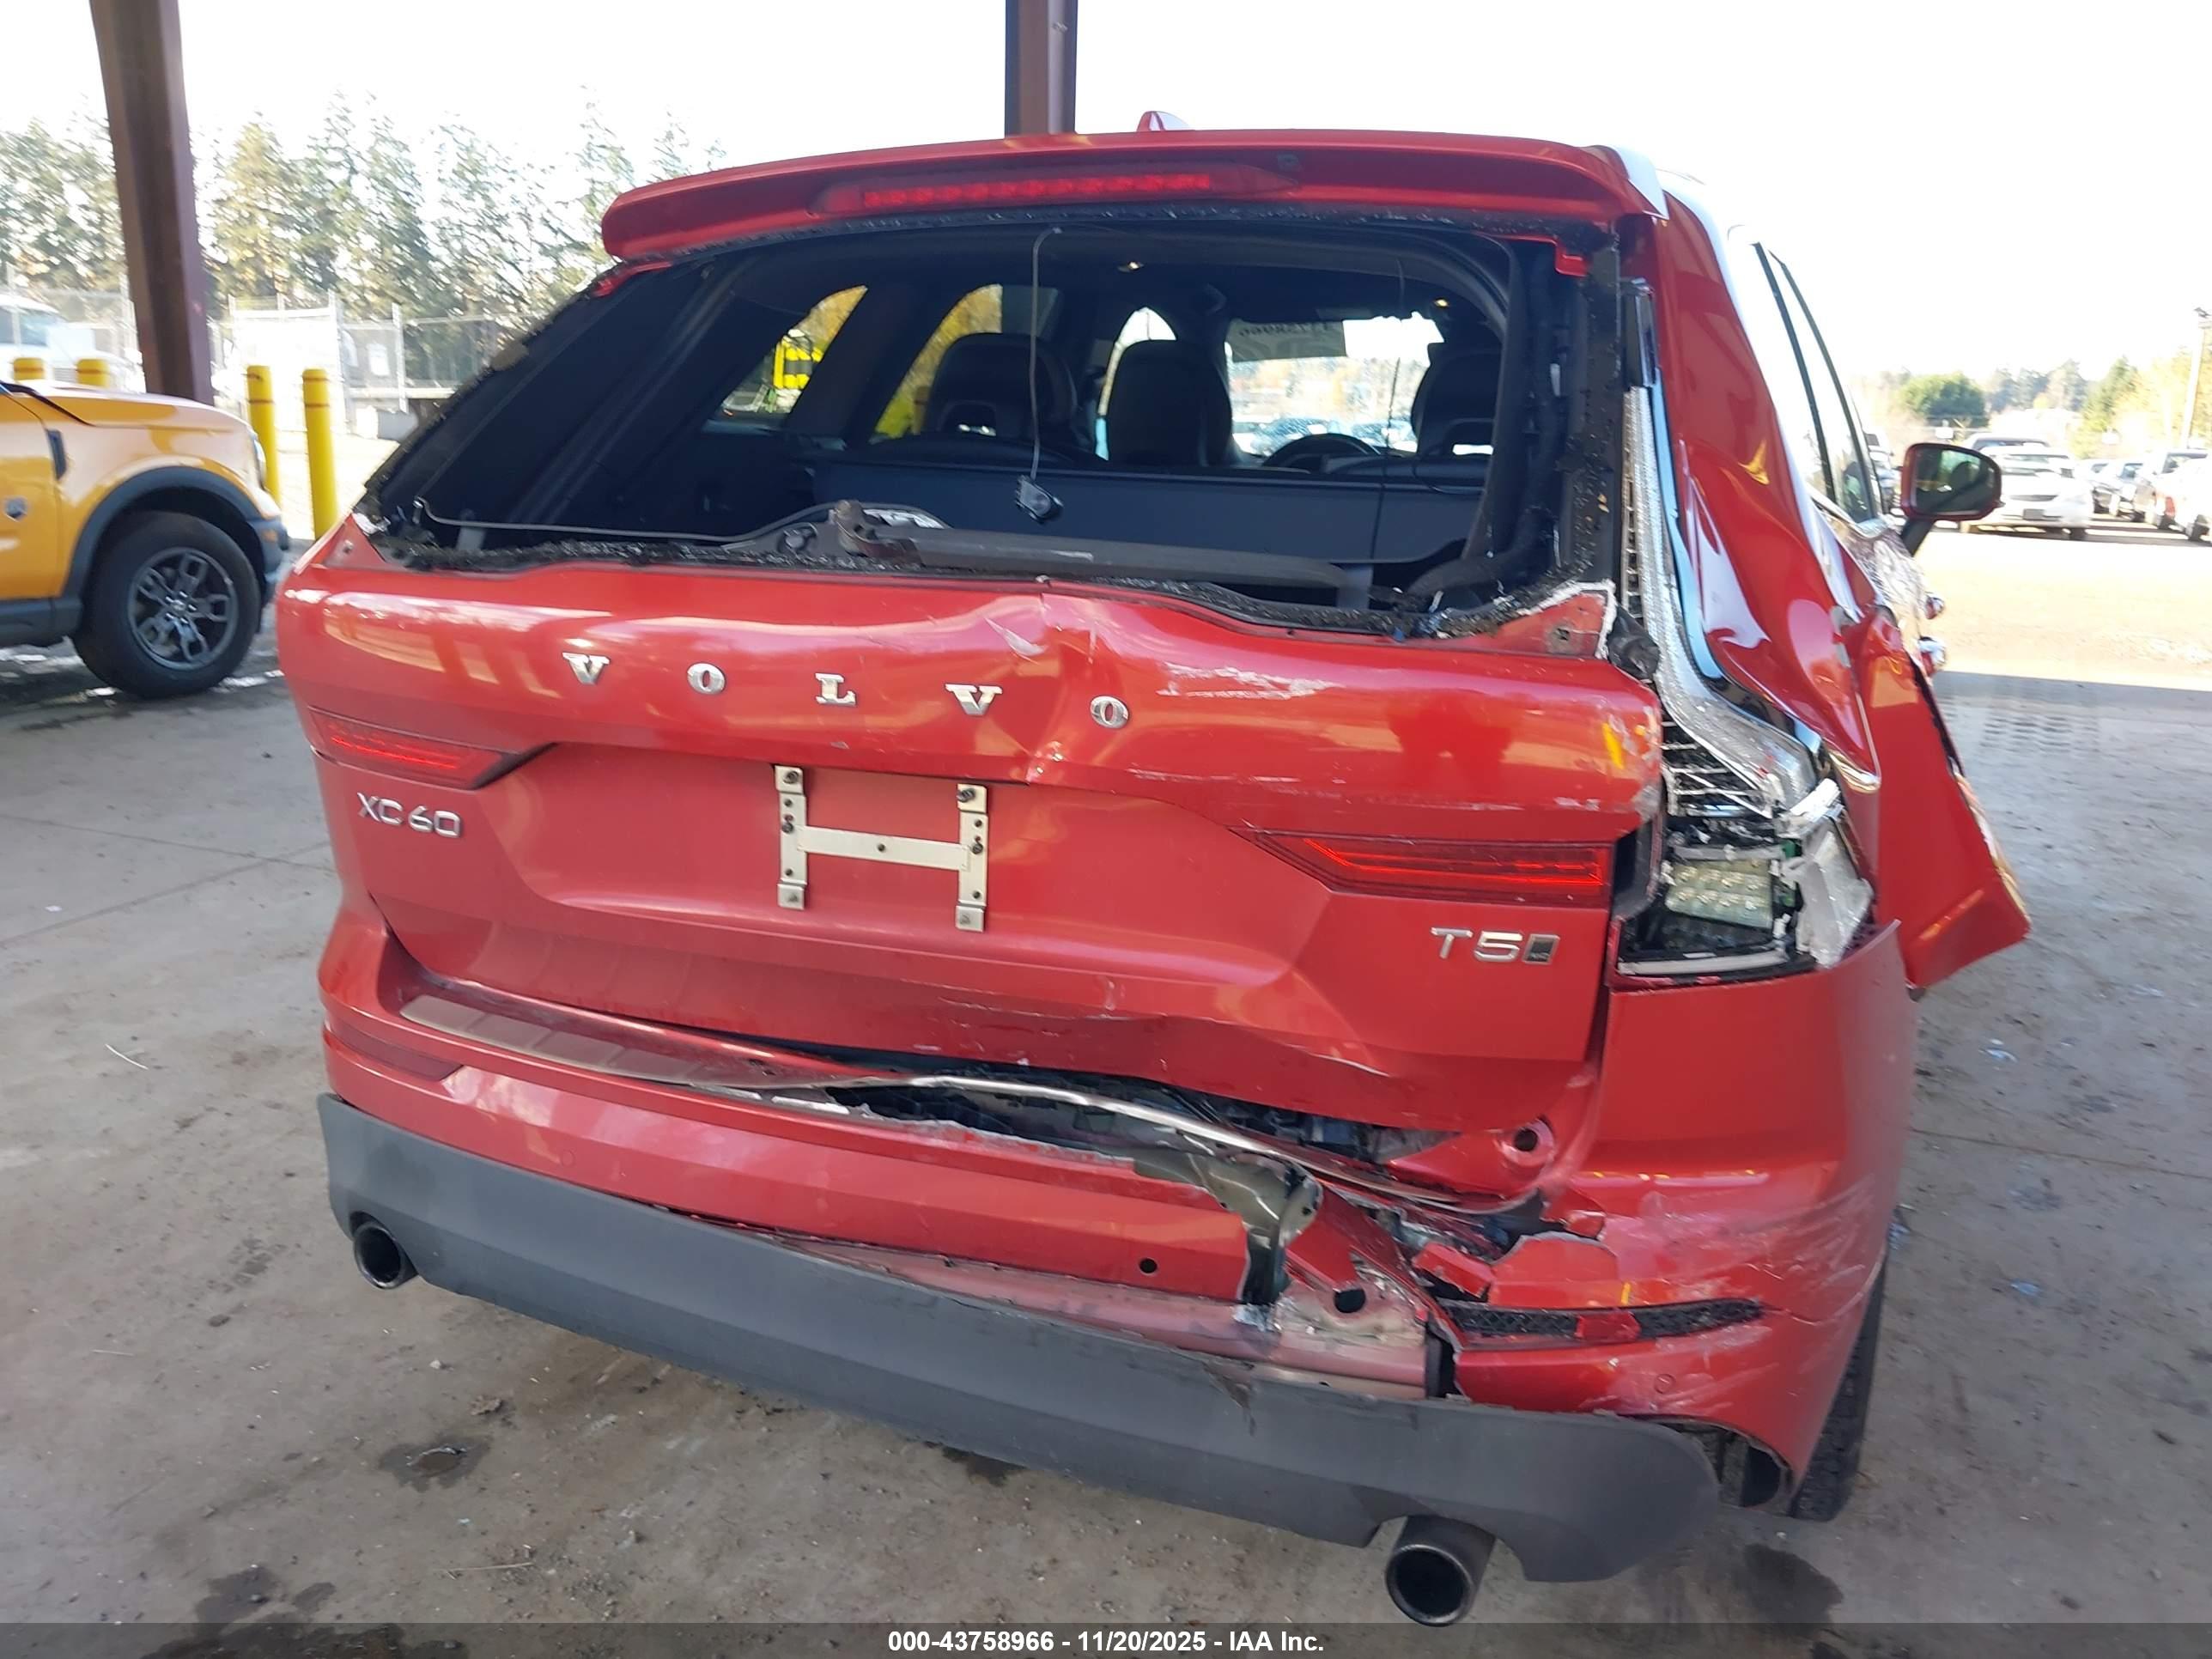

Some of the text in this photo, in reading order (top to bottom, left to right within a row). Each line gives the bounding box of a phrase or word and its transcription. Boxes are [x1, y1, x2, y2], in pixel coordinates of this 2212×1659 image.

[562, 652, 1129, 729] VOLVO
[356, 792, 461, 838] XC60
[1430, 927, 1523, 963] T5
